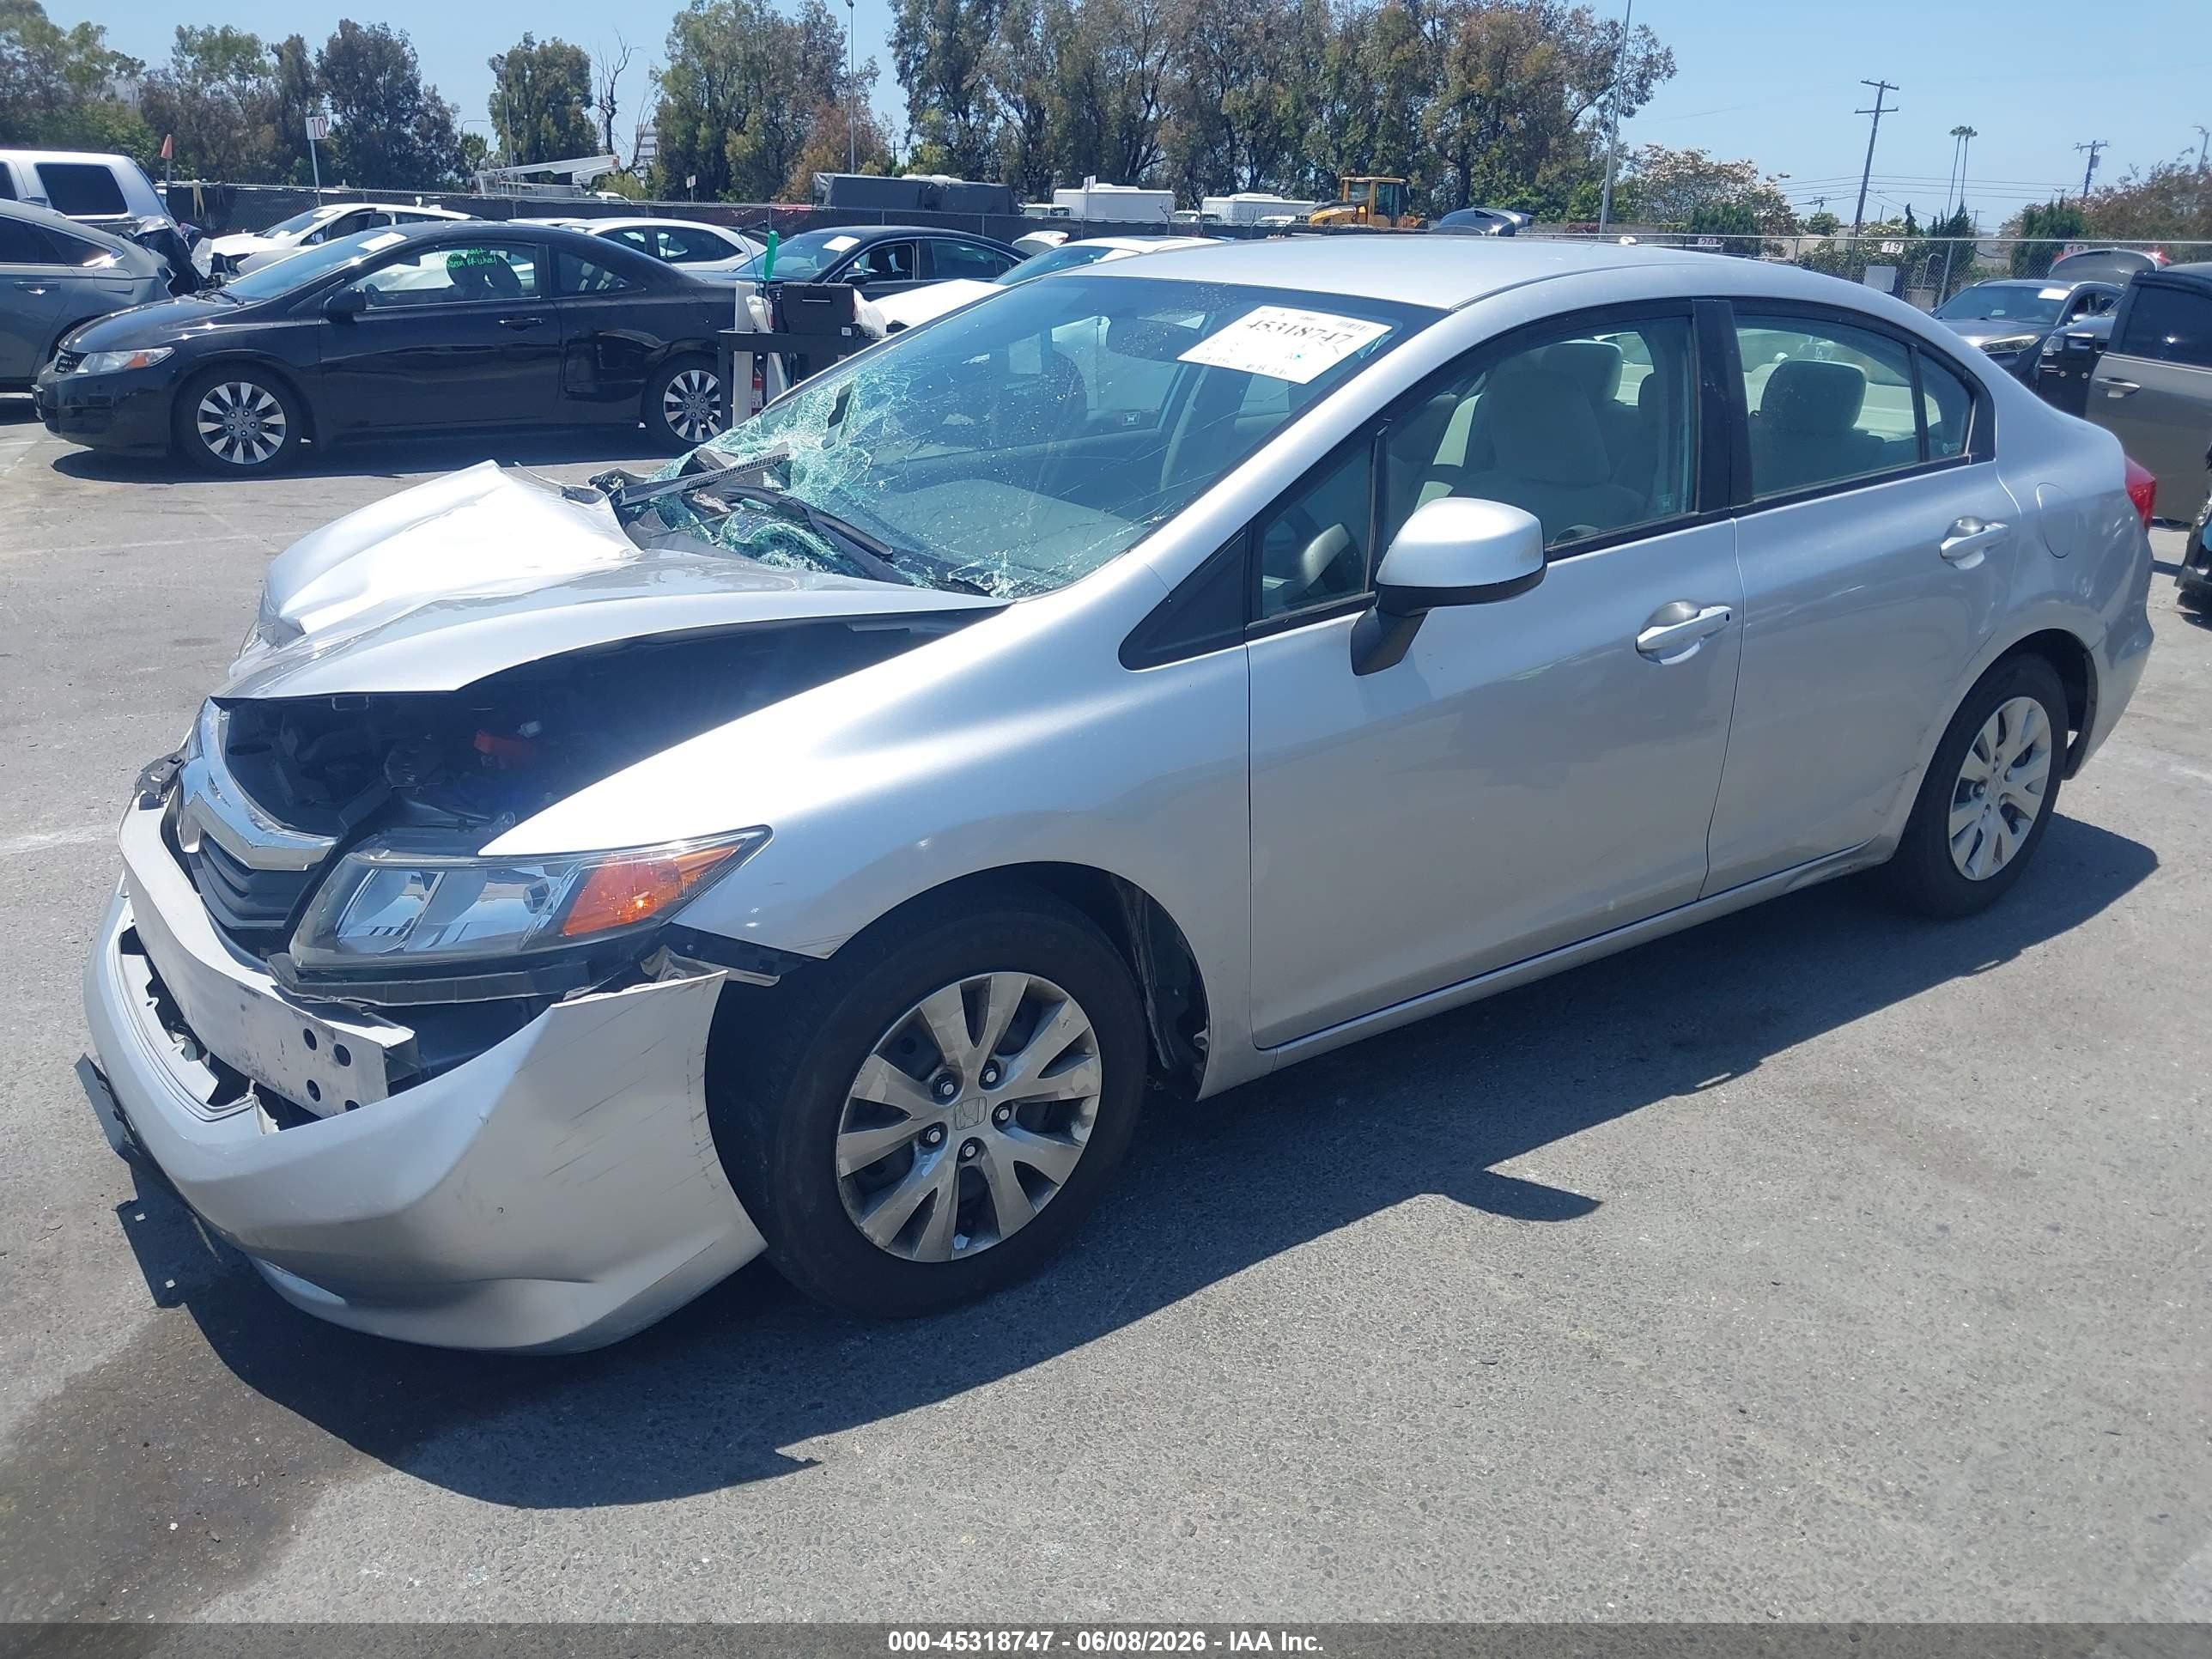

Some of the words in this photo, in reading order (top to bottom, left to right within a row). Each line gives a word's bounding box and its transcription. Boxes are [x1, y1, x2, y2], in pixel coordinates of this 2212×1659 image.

[311, 118, 326, 138] 10
[1887, 242, 1900, 252] 19
[1246, 319, 1355, 344] 45318747
